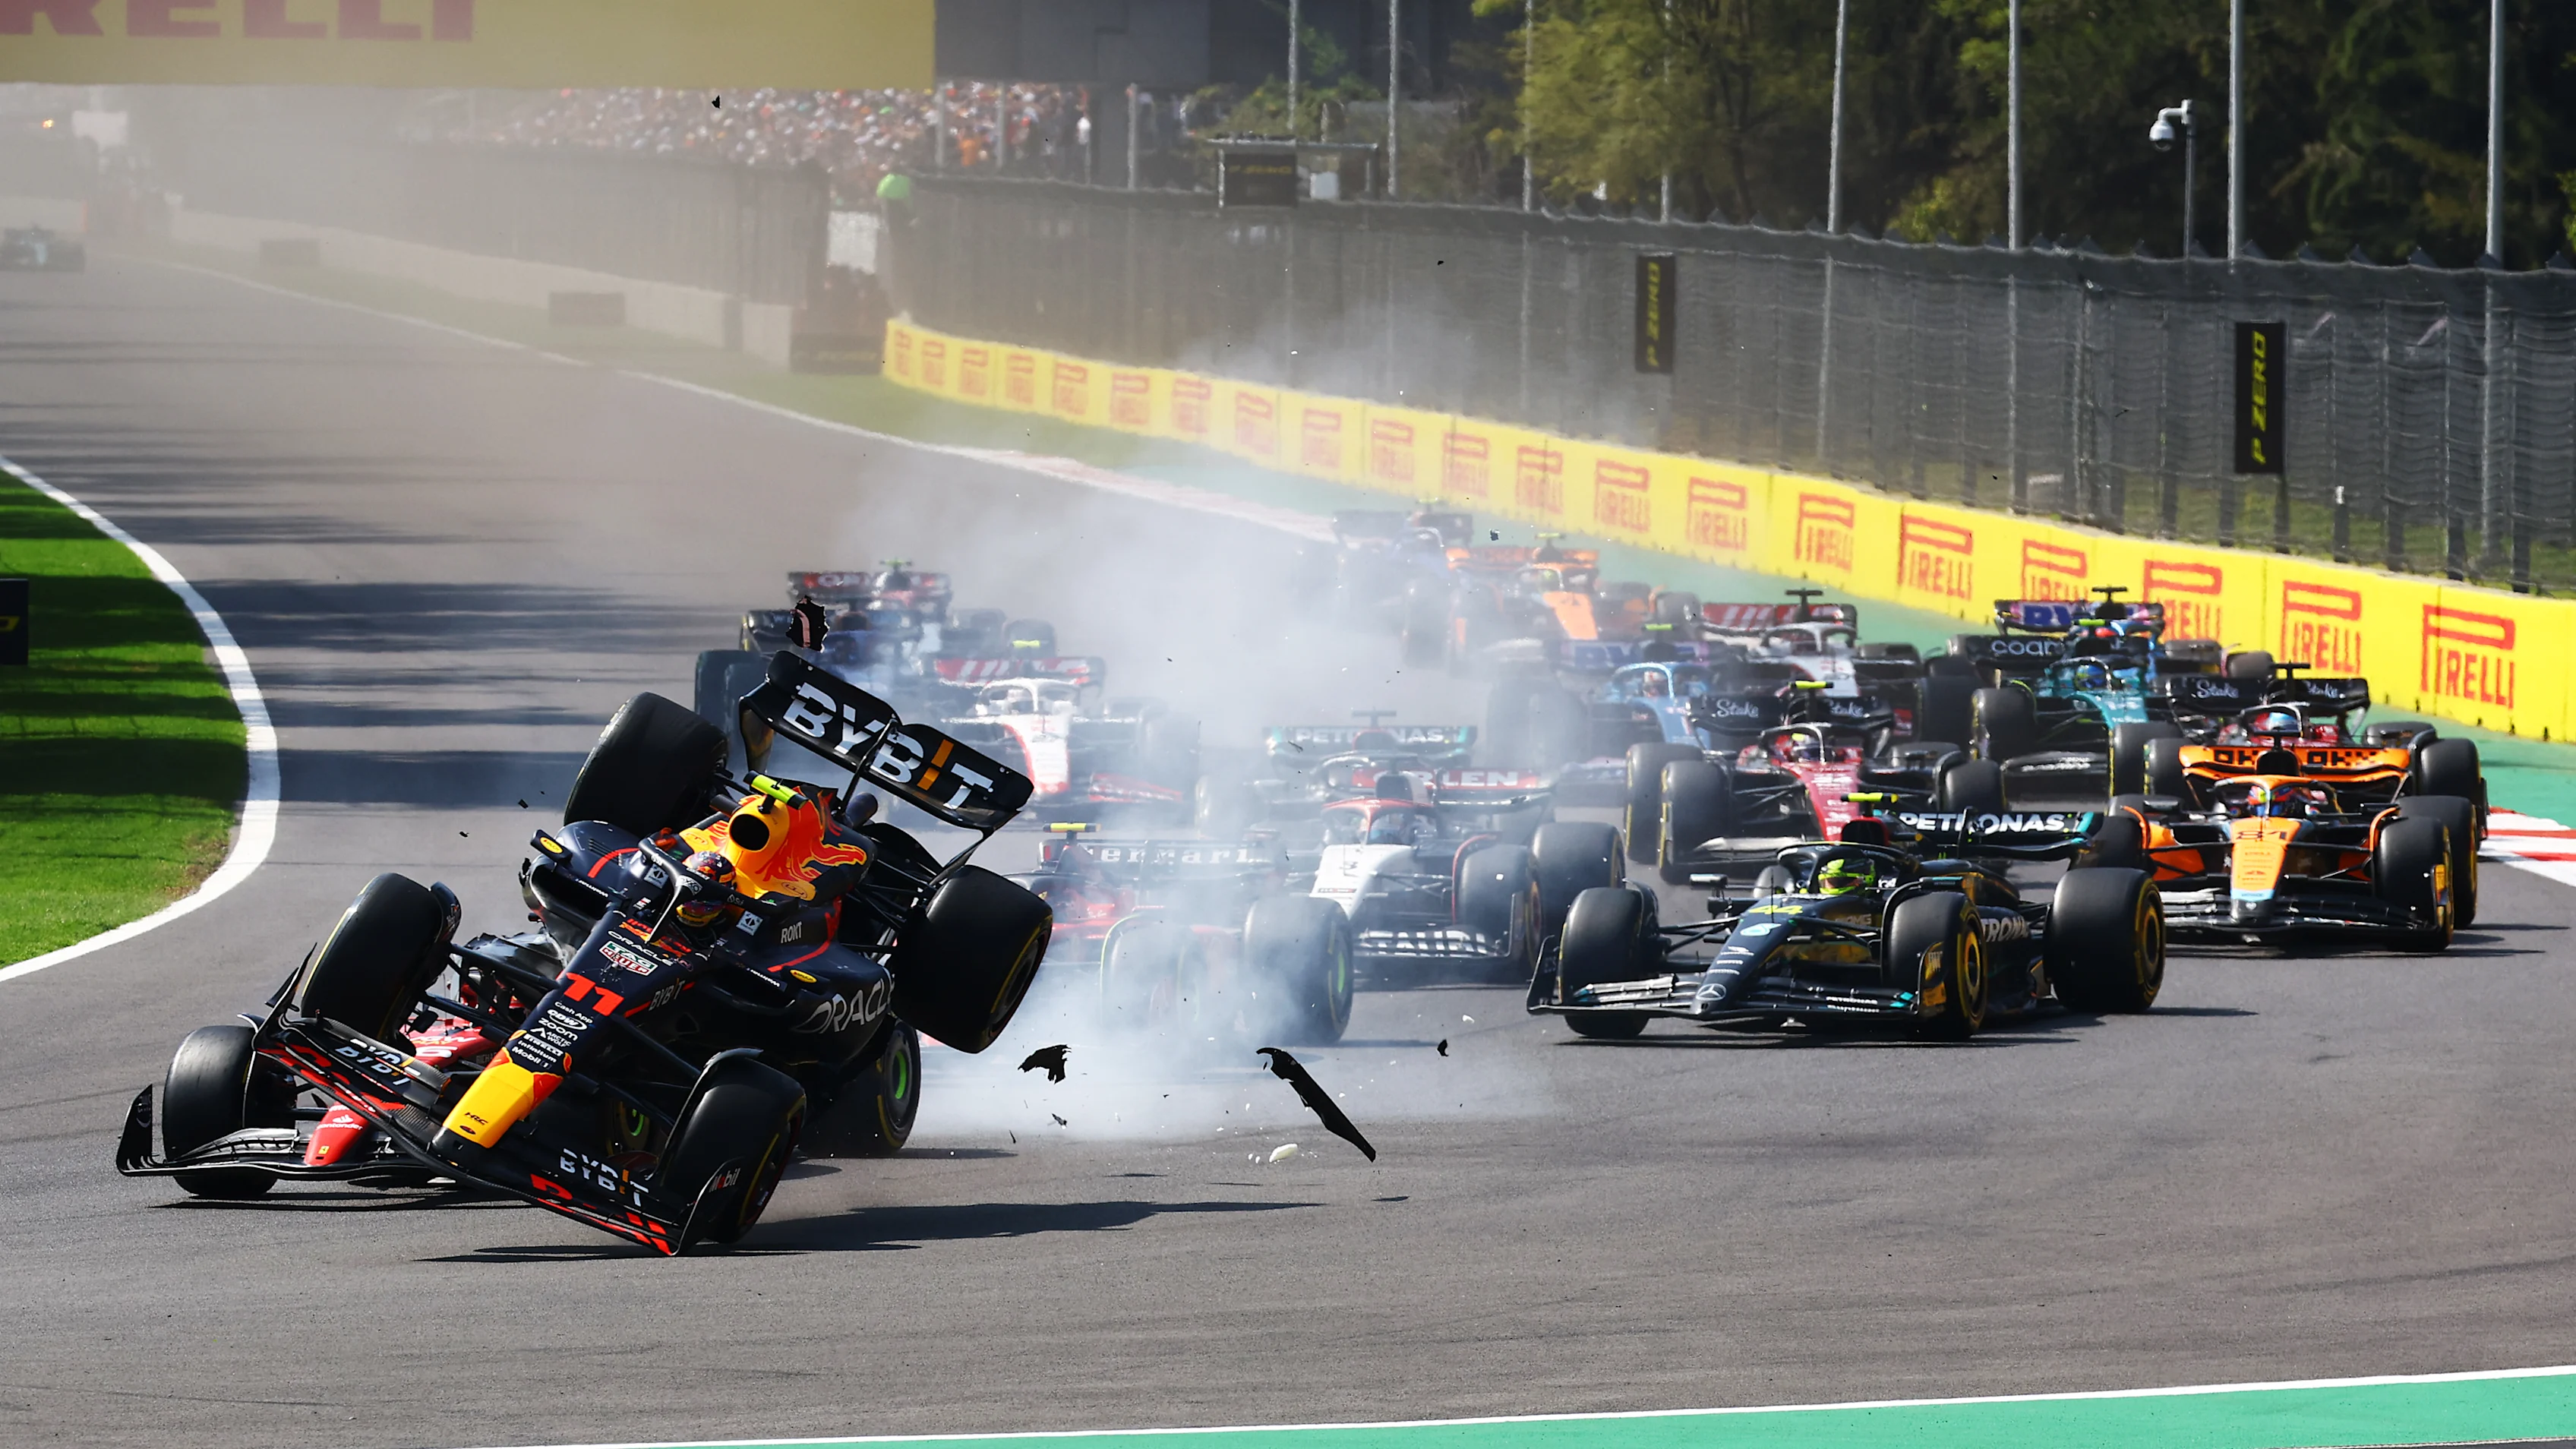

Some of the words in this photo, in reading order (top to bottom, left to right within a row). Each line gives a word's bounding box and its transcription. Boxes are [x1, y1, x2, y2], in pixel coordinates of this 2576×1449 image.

[2252, 330, 2267, 432] ZERO
[2252, 437, 2267, 465] P
[1687, 477, 1746, 550] PIRELLI
[1795, 494, 1855, 570] PIRELLI
[1898, 515, 1973, 600] PIRELLI
[2281, 581, 2362, 672] PIRELLI
[2421, 605, 2515, 708] PIRELLI
[1716, 699, 1759, 718] Stake
[783, 682, 993, 809] BYBIT
[1981, 917, 2030, 942] TRONA
[608, 930, 674, 967] ORACLE
[611, 942, 654, 970] TAG
[564, 972, 624, 1017] 11
[649, 977, 686, 1012] BYBIT
[547, 1009, 581, 1026] CDW
[554, 1000, 575, 1015] Cash
[574, 1011, 594, 1024] App
[538, 1017, 579, 1041] zoom
[546, 1031, 572, 1046] ARCTIC
[547, 1035, 567, 1048] WOLF
[511, 1046, 541, 1065] Mobil
[464, 1111, 489, 1125] HRC
[709, 1167, 741, 1193] Mobil
